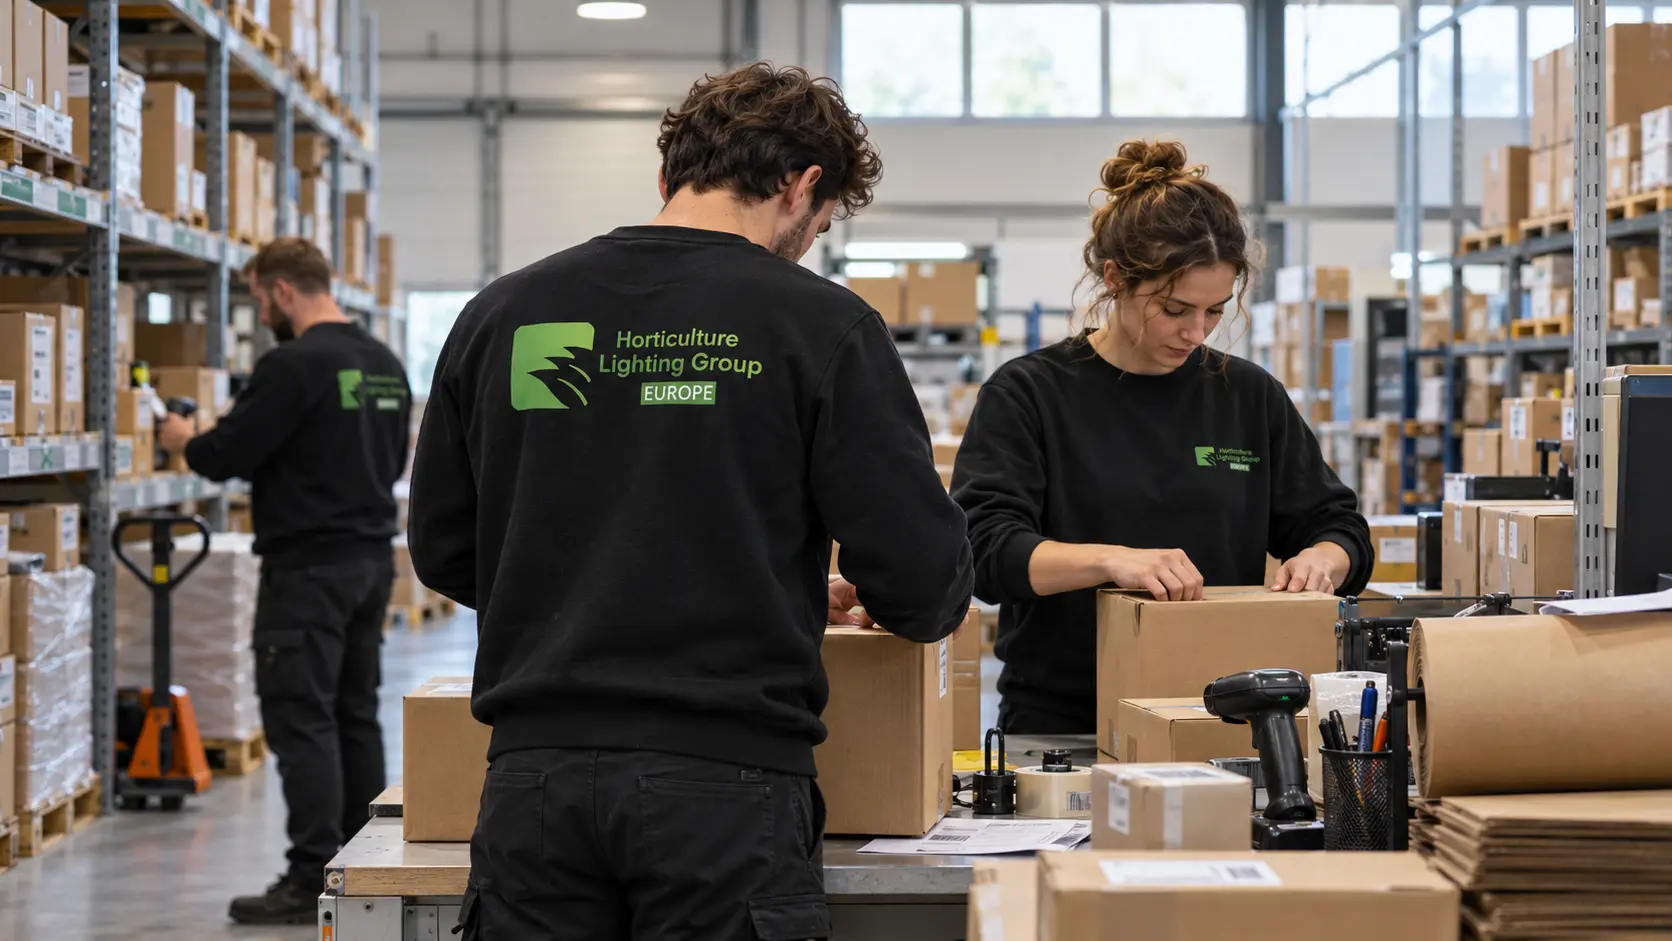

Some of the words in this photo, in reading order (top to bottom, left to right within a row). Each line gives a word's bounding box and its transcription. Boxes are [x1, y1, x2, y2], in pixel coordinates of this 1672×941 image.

[616, 328, 739, 349] Horticulture
[599, 353, 685, 377] Lighting
[691, 352, 763, 379] Group
[644, 385, 713, 401] EUROPE
